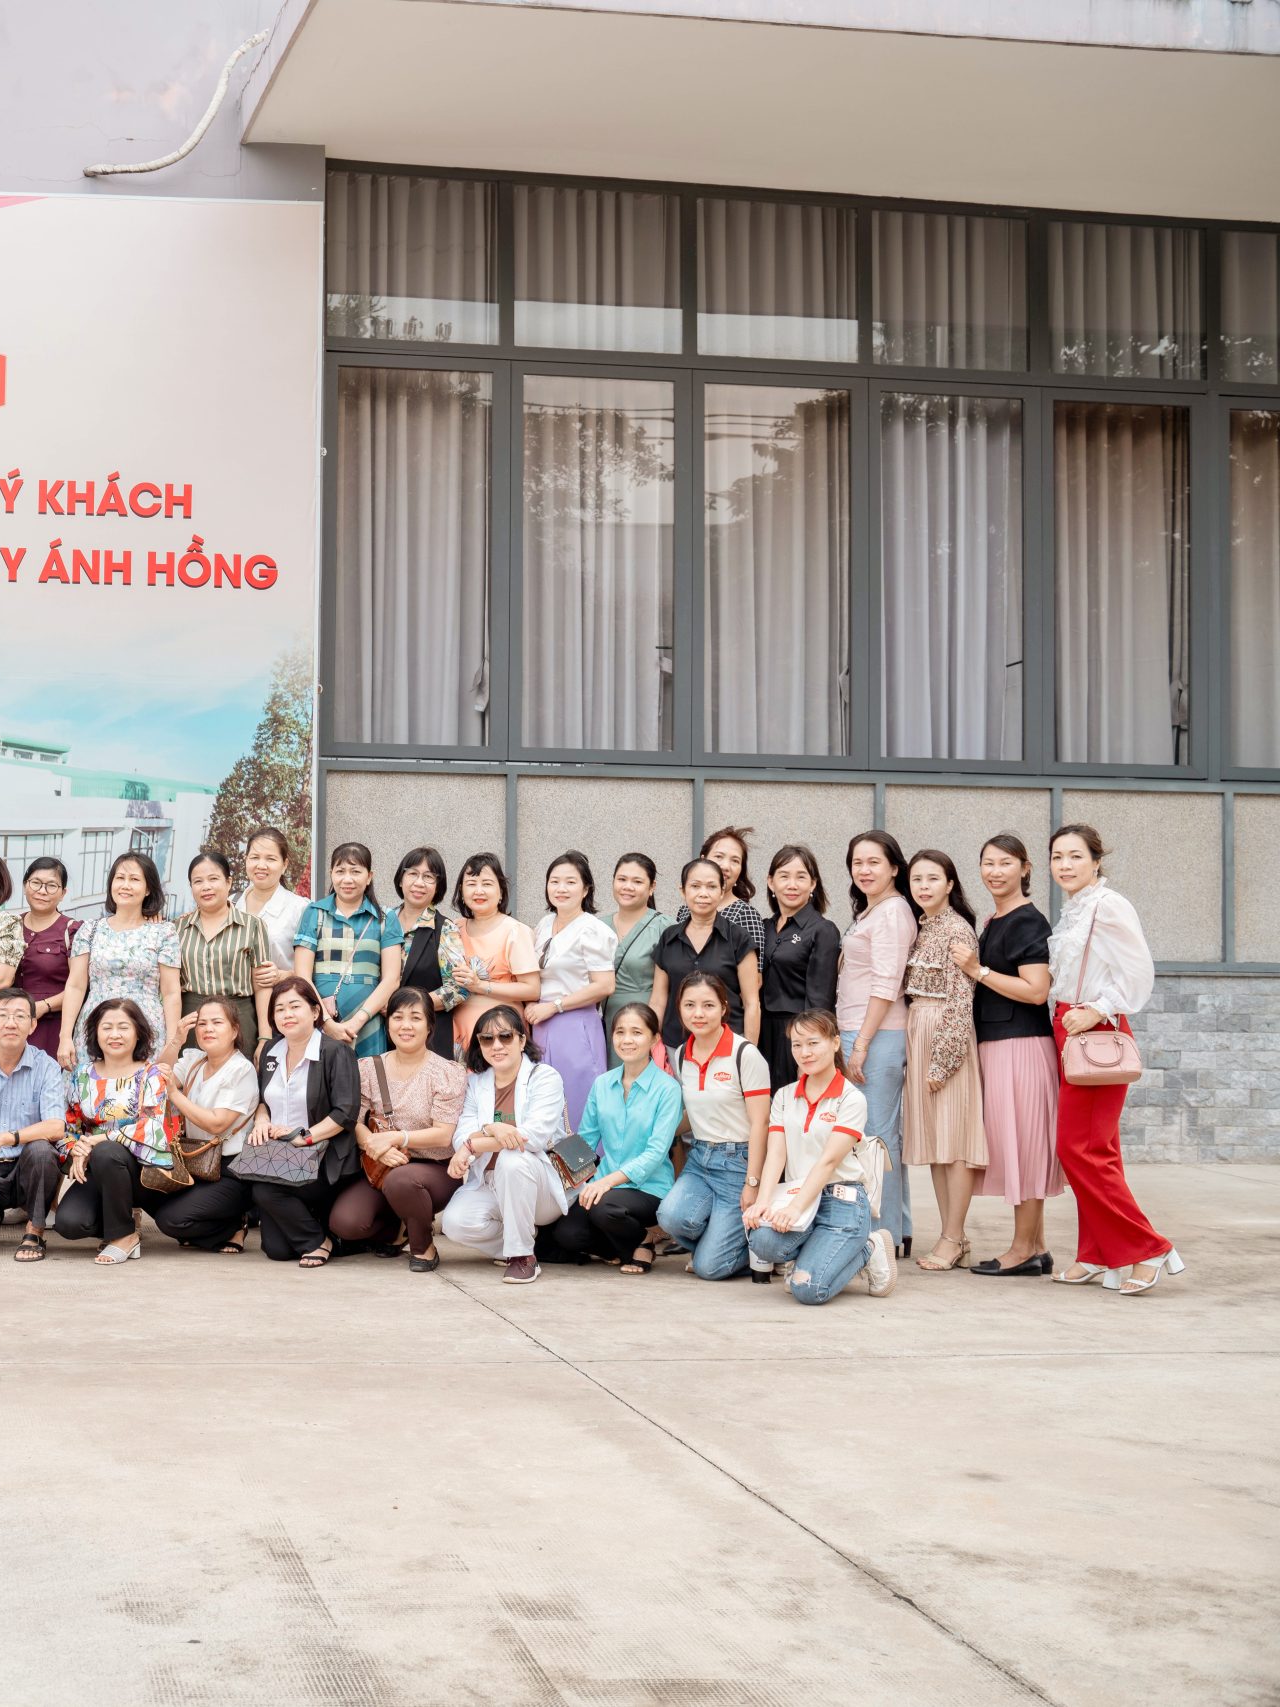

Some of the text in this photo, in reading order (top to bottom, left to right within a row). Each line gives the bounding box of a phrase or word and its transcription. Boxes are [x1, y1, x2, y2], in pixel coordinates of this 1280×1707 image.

[38, 471, 193, 519] KHÁCH
[38, 538, 132, 585] ÁNH
[147, 534, 278, 590] HỒNG
